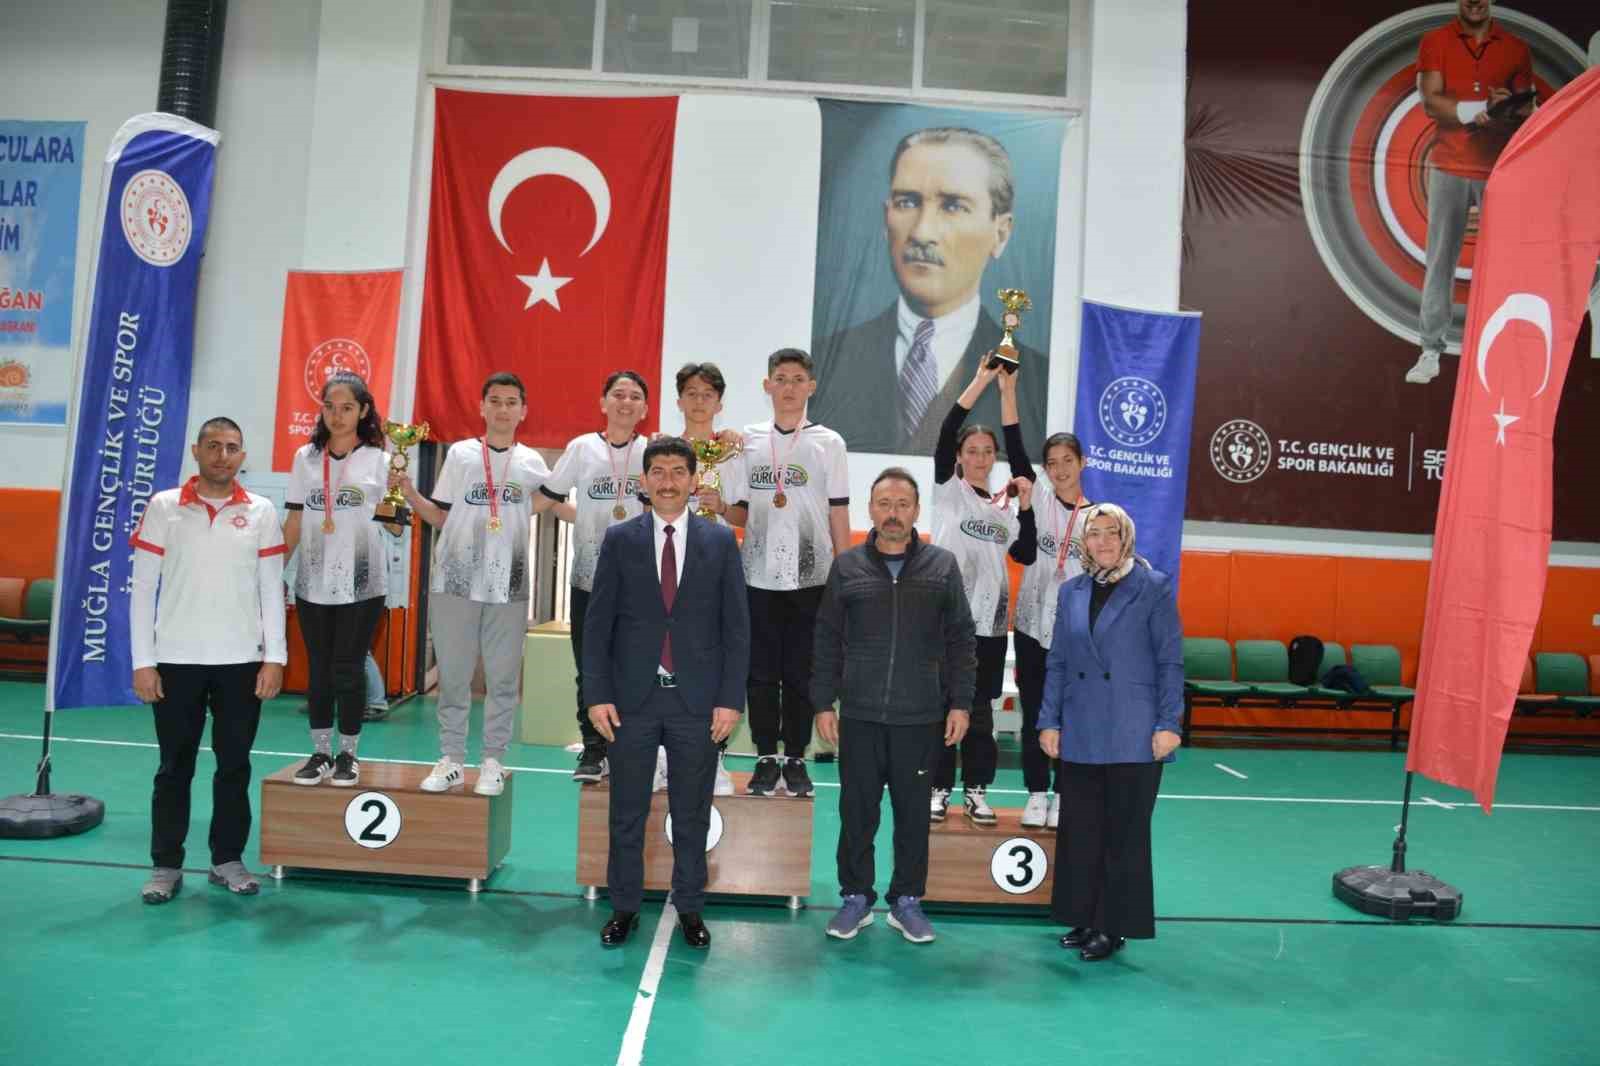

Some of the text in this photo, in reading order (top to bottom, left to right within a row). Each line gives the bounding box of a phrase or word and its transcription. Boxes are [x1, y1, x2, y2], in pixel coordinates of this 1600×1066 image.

[1089, 445, 1170, 465] T.C. GENÇLİK VE
[1278, 440, 1394, 460] T.C. GENÇLİK VE
[1087, 457, 1173, 478] SPOR BAKANLIĞI
[1278, 457, 1394, 477] SPOR BAKANLIĞI
[81, 311, 141, 664] MUĞLA GENÇLİK VE SPOR
[359, 799, 387, 842] 2
[1006, 845, 1033, 887] 3
